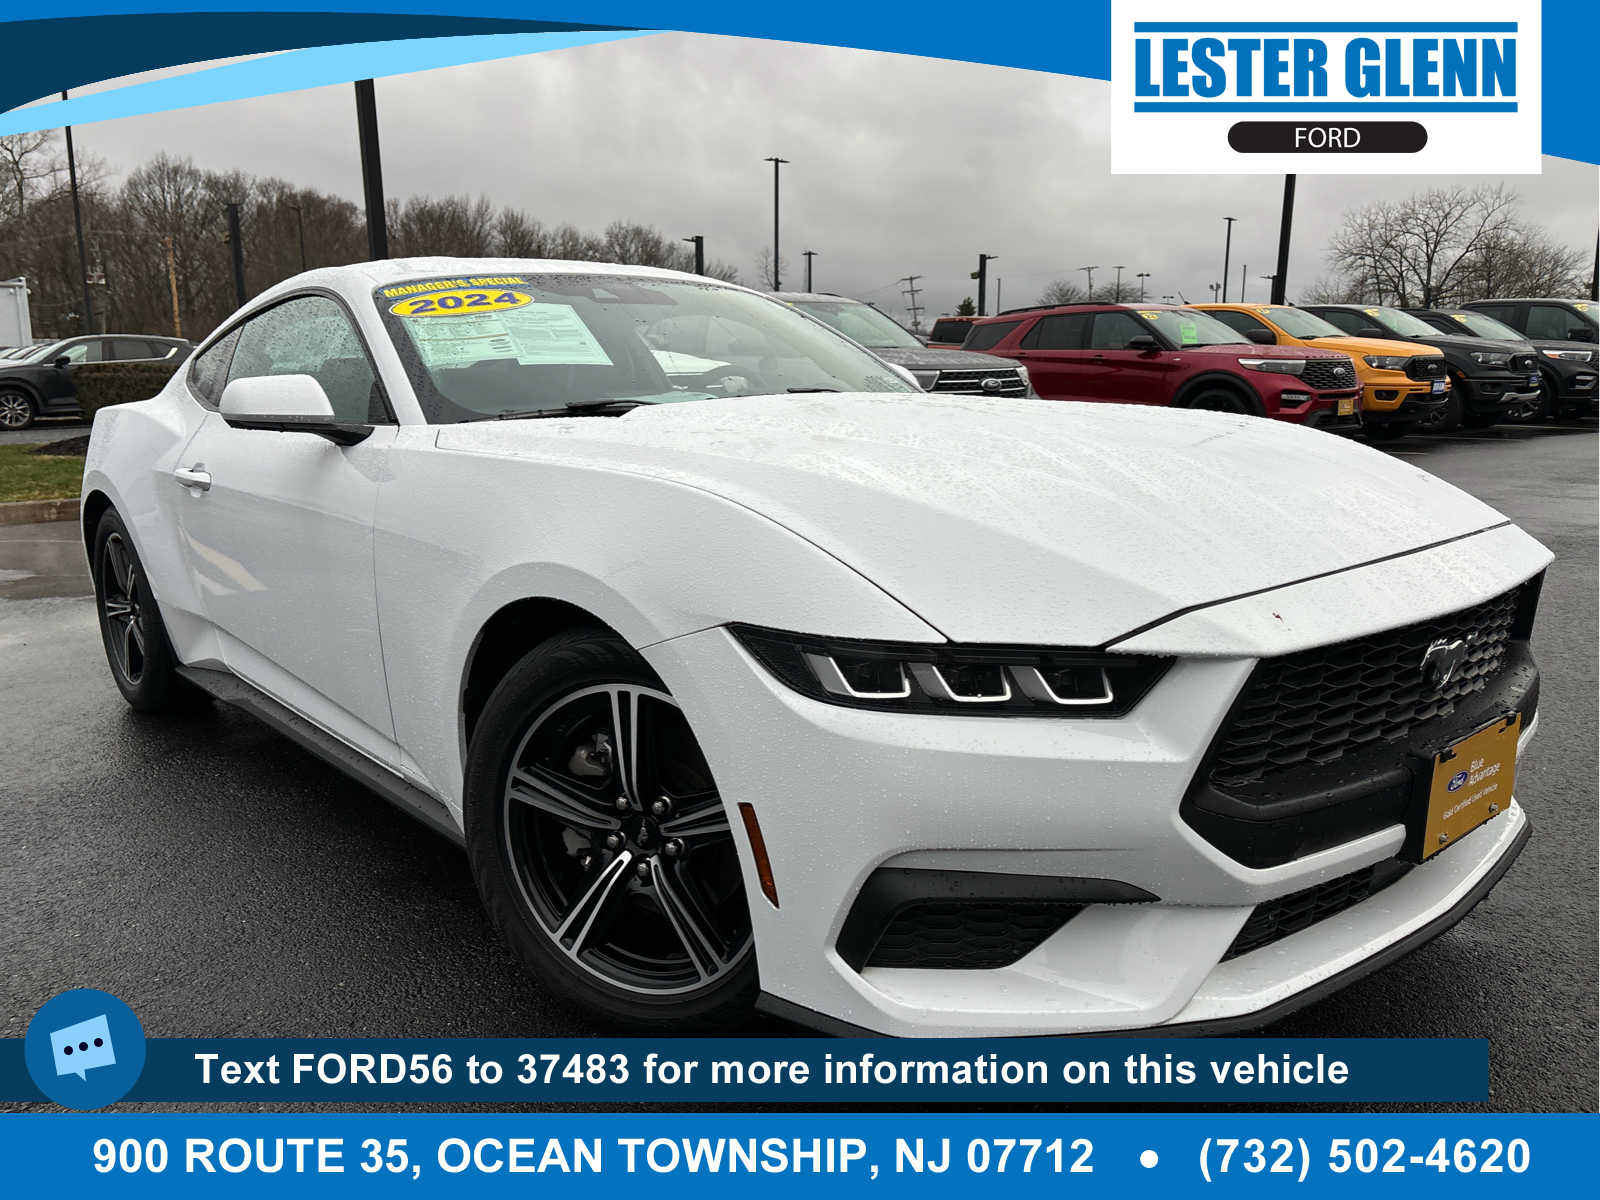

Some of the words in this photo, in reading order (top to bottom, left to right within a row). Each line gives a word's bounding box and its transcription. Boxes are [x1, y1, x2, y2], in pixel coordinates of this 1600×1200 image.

[383, 279, 468, 298] MANAGER'S
[469, 276, 528, 287] SPECIAL
[409, 291, 521, 315] 2024
